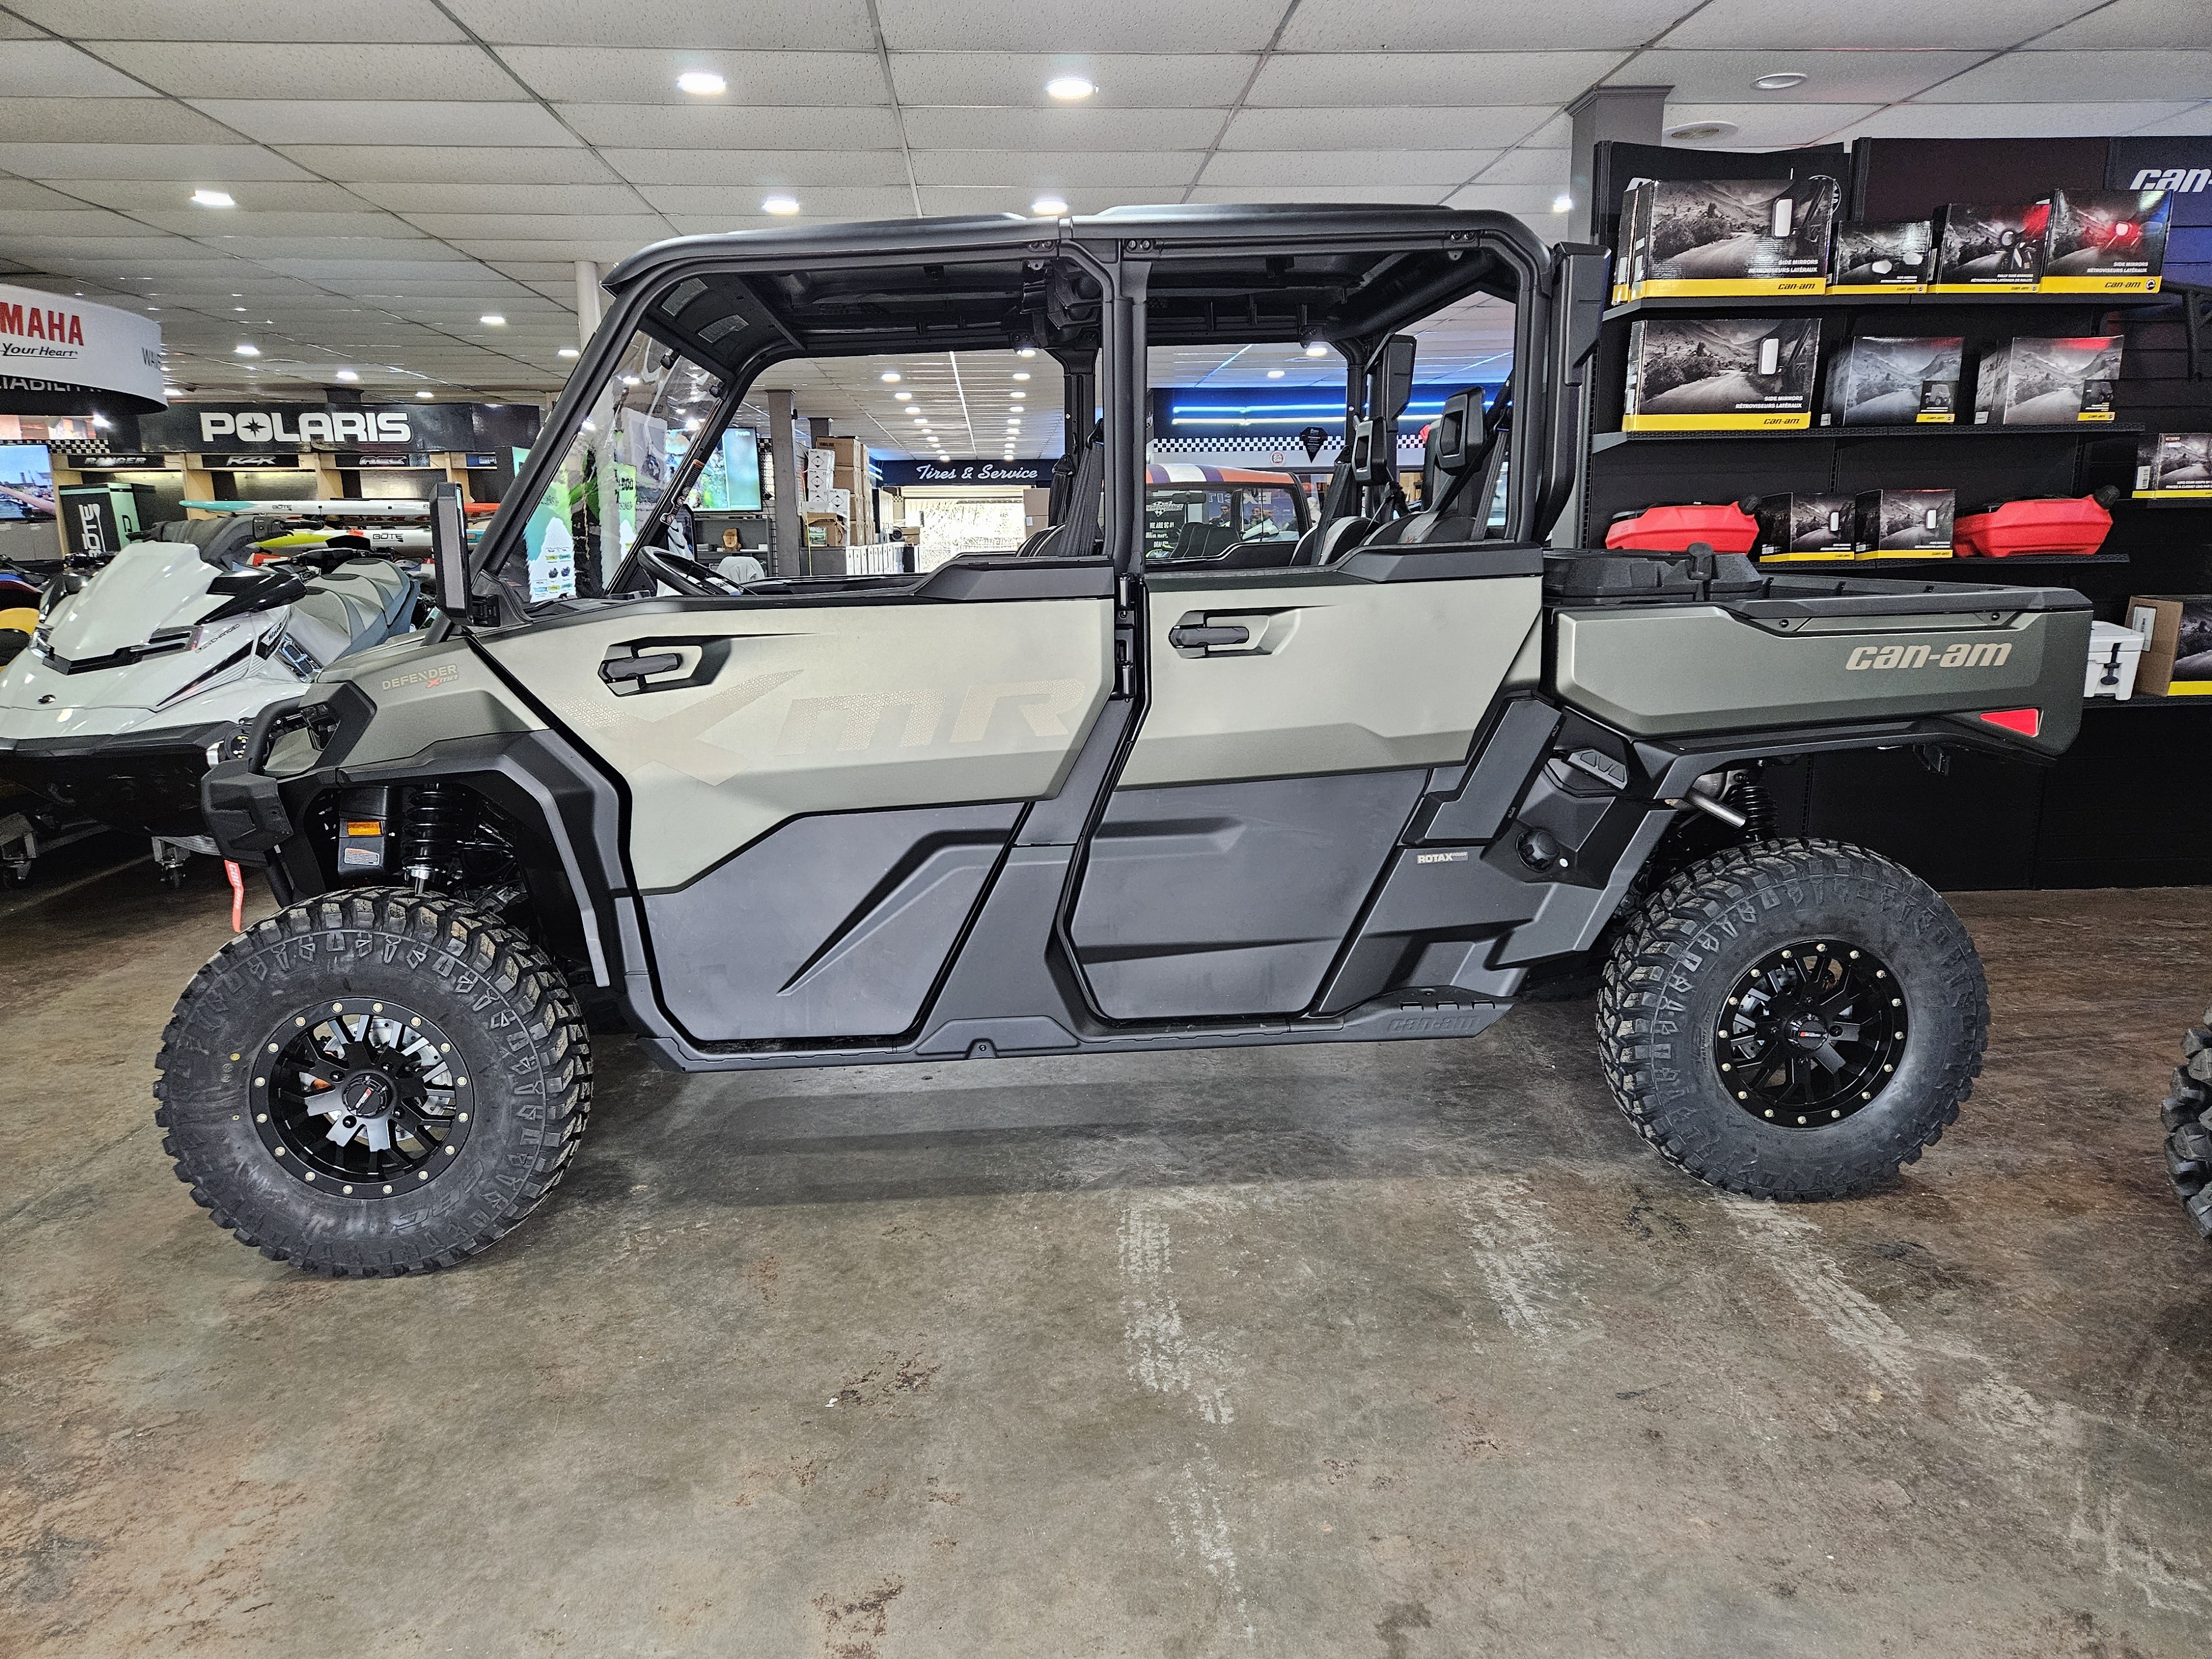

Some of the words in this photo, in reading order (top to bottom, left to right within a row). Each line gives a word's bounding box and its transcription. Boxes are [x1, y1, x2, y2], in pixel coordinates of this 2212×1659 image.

[200, 412, 411, 442] POLARIS
[226, 455, 276, 466] RZR
[916, 464, 957, 479] Tires
[961, 467, 974, 479] &
[977, 463, 1039, 479] Service
[1845, 643, 2013, 671] can-am
[381, 664, 458, 691] DEFENDER
[1417, 853, 1453, 864] ROTAX
